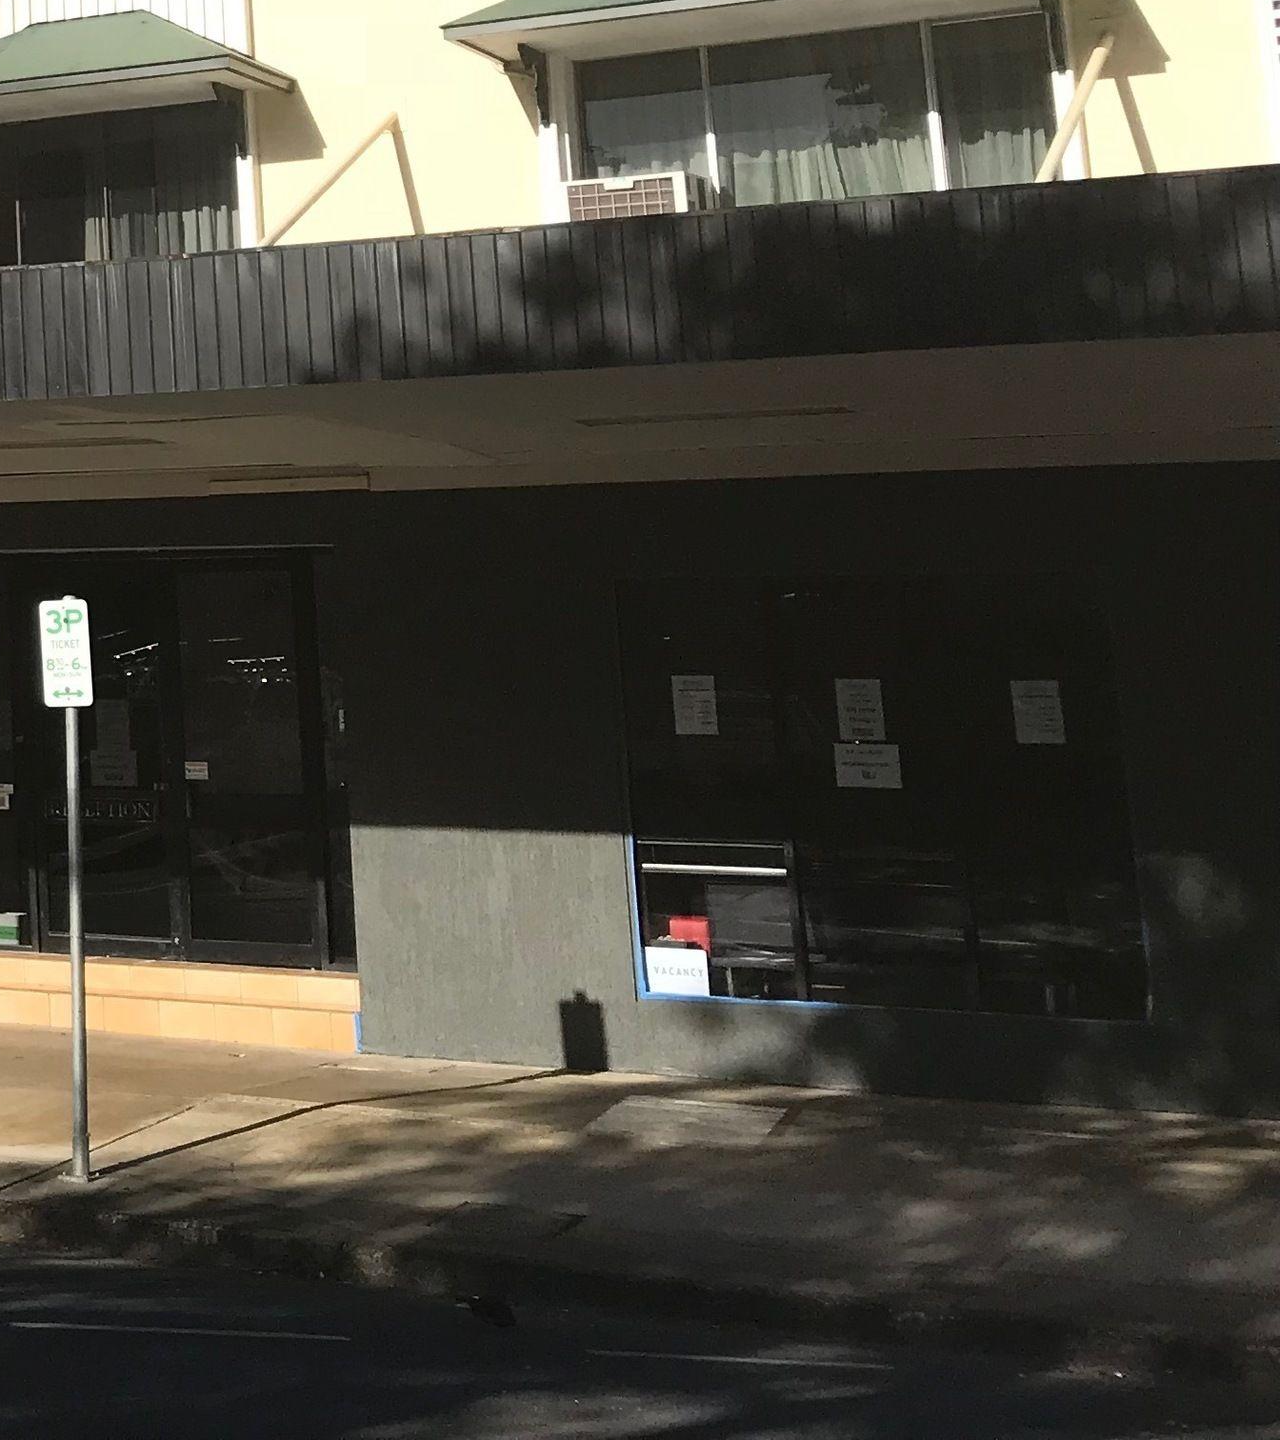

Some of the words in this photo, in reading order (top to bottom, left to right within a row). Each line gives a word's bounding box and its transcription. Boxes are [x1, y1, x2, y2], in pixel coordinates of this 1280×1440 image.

[46, 609, 83, 634] 3P
[50, 639, 80, 649] TICKET
[653, 966, 704, 977] VACANCY
